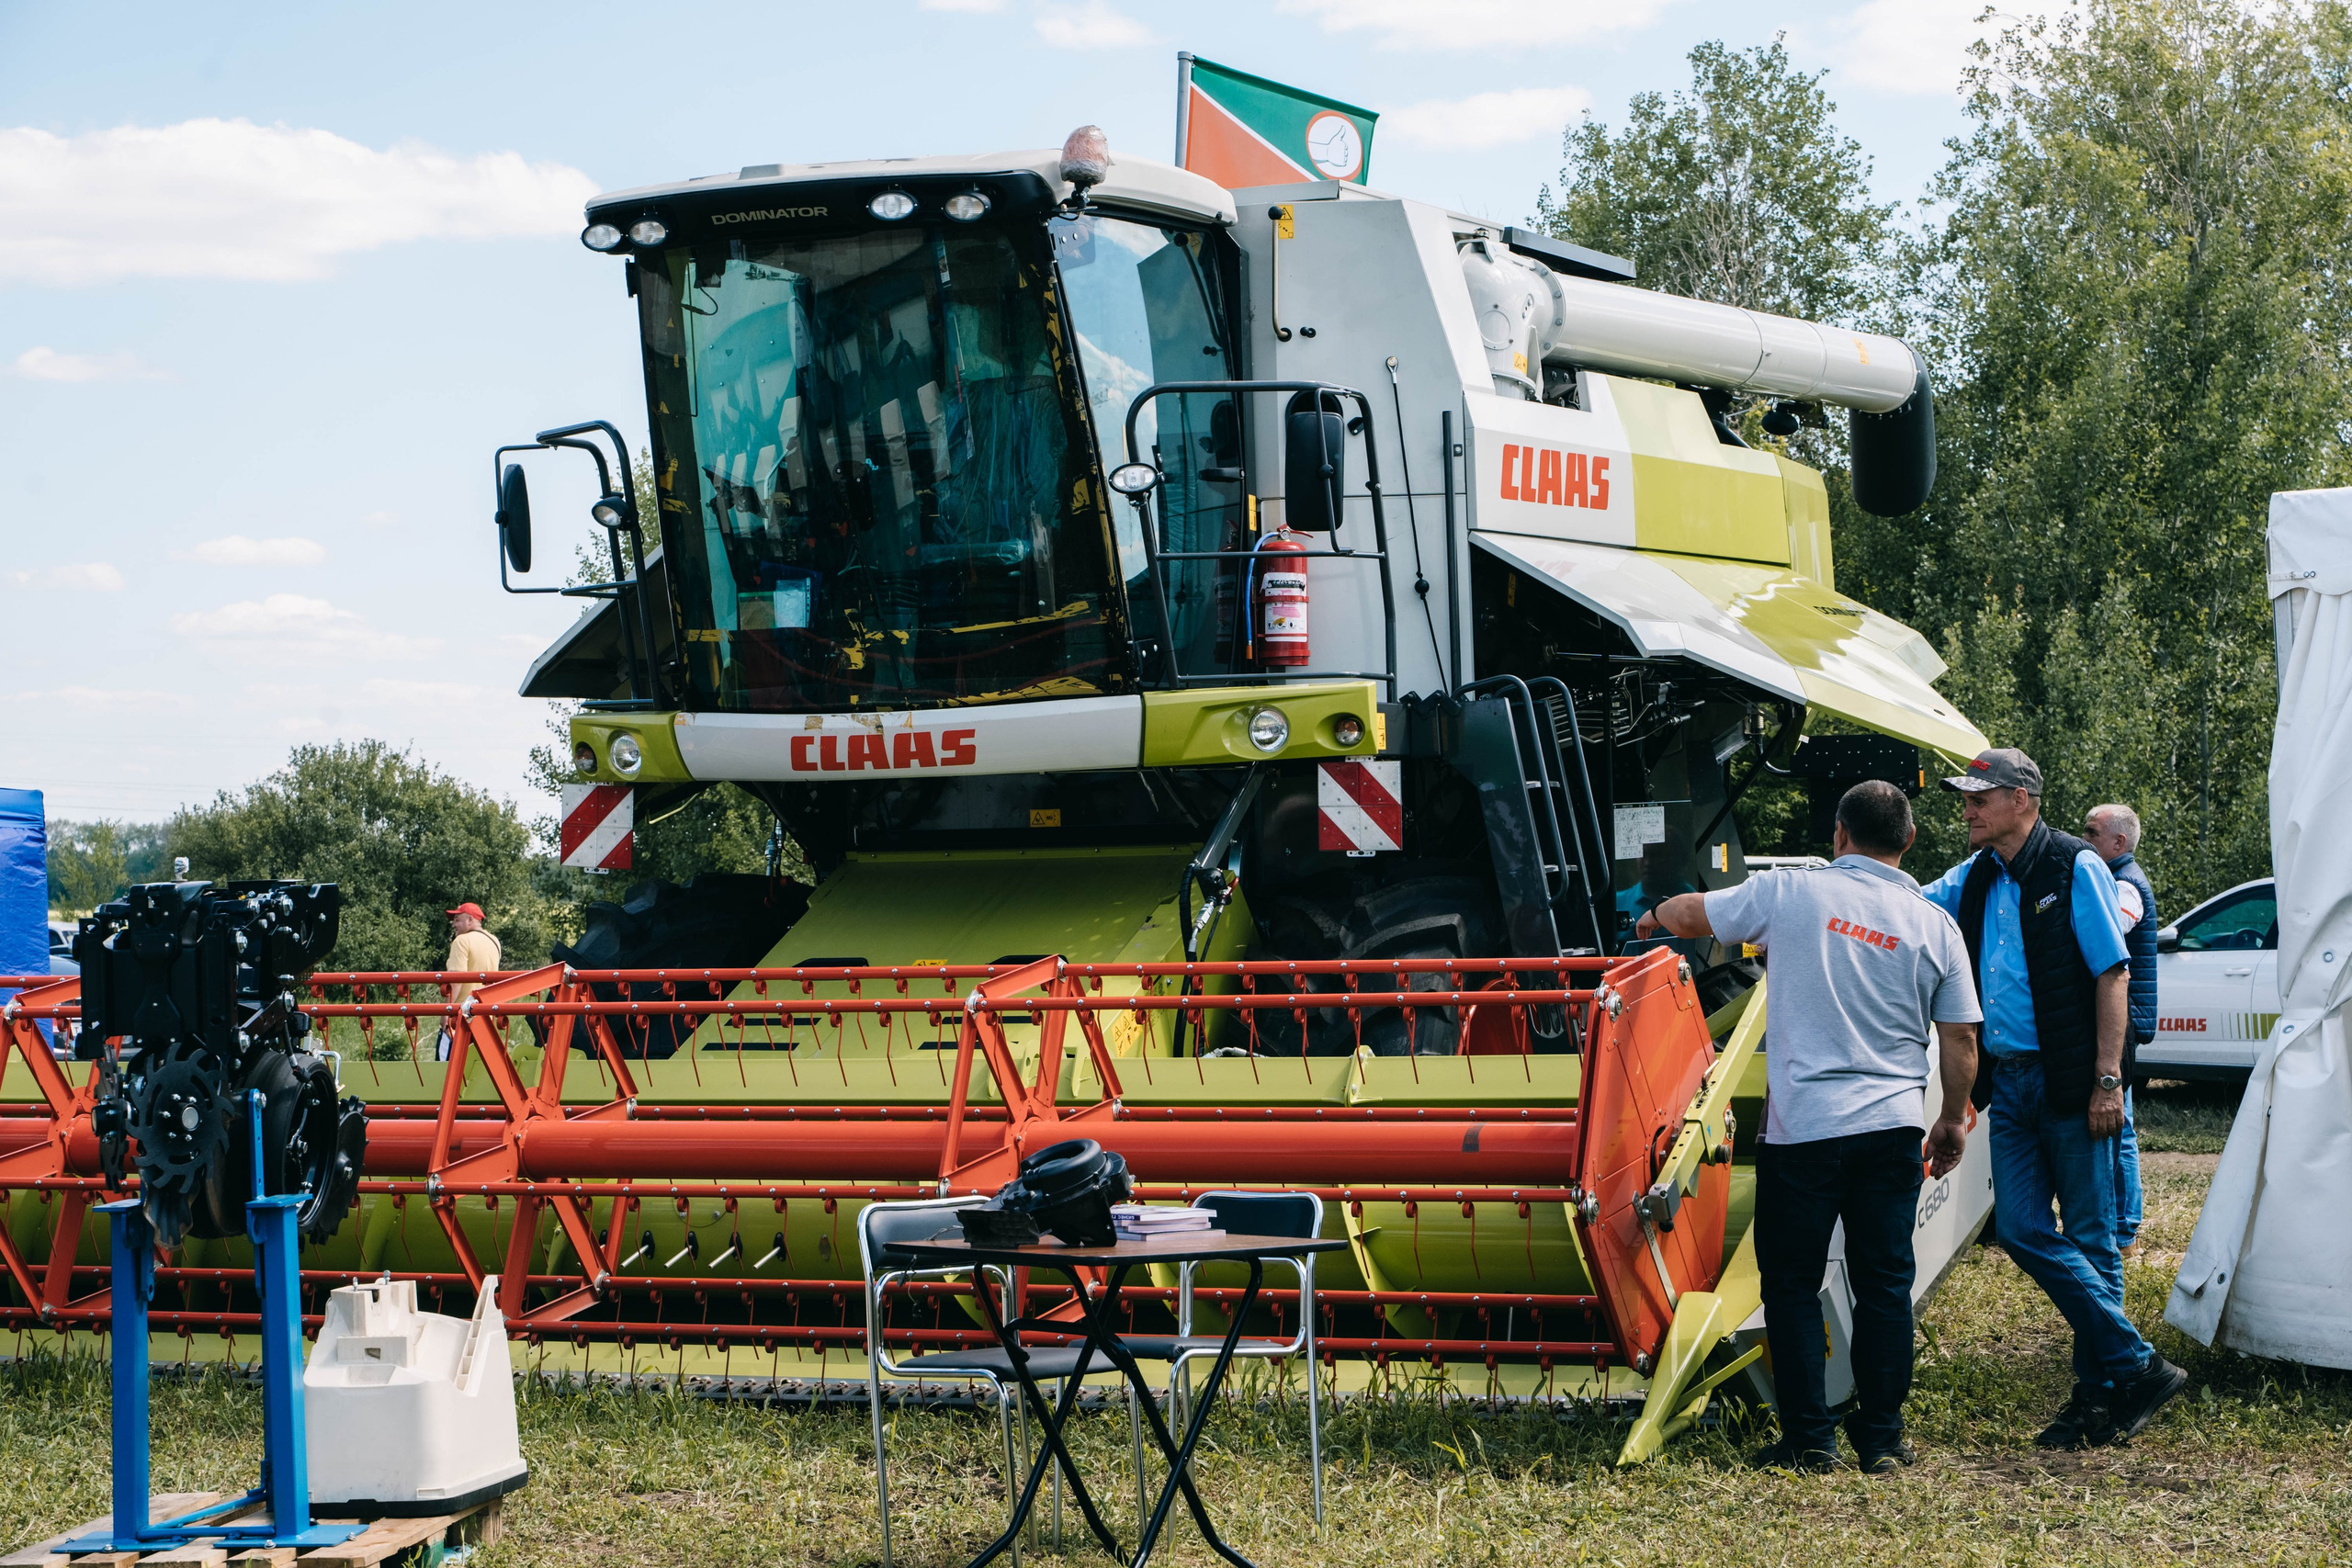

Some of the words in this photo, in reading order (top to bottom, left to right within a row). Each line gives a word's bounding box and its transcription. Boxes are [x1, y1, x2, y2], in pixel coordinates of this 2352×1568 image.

[711, 207, 828, 225] DOMINATOR
[1500, 444, 1610, 511] CLAAS
[790, 728, 976, 772] CLAAS
[1826, 917, 1901, 951] CLAAS
[2158, 1018, 2207, 1032] CLAAS
